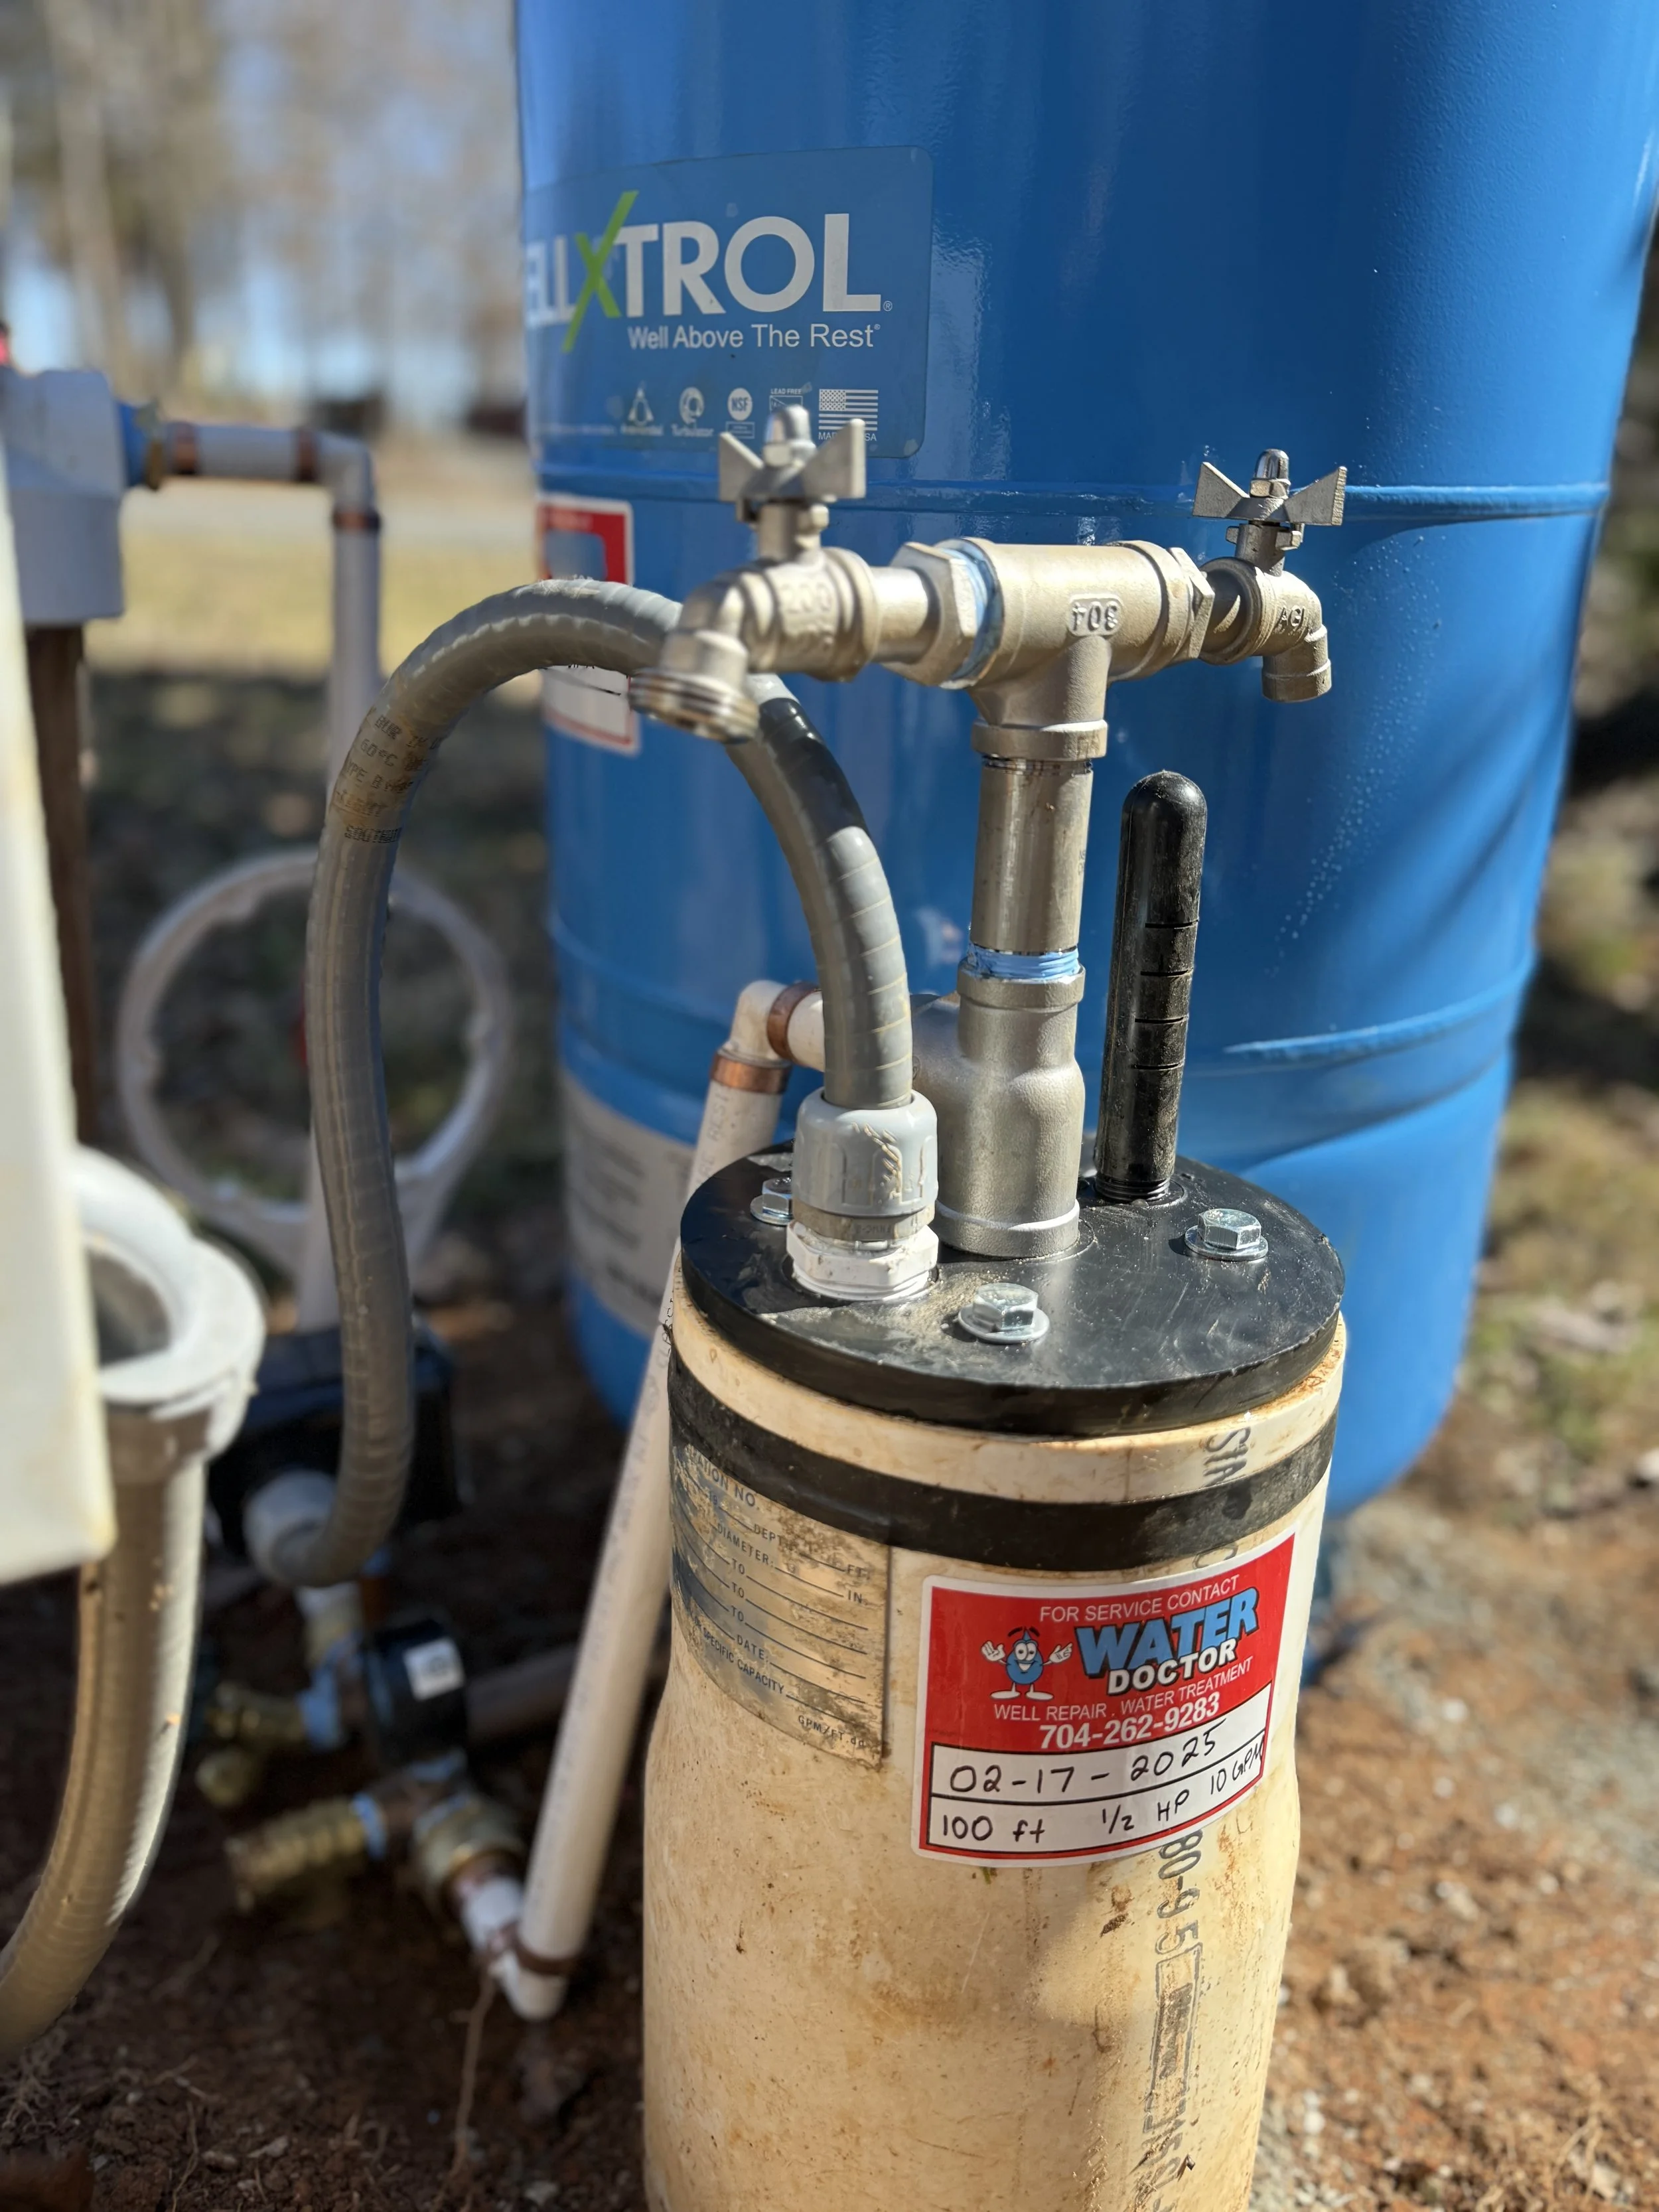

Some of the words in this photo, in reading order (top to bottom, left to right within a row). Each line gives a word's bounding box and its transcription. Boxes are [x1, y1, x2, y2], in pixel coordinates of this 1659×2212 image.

[627, 325, 669, 350] Well
[673, 325, 744, 349] Above
[751, 324, 800, 347] The
[810, 323, 874, 348] Rest
[731, 397, 750, 412] NSF
[818, 432, 836, 441] MA
[731, 1582, 745, 1599] TO
[732, 1558, 745, 1576] TO
[731, 1605, 745, 1623] TO
[1039, 1605, 1079, 1623] FOR
[1084, 1597, 1162, 1621] SERVICE
[1167, 1574, 1240, 1610] CONTACT
[1073, 1586, 1260, 1678] WATER
[703, 1627, 735, 1663] SPECIFIC
[737, 1659, 784, 1694] CAPACITY
[1106, 1637, 1238, 1696] DOCTOR
[994, 1703, 1041, 1721] WELL
[1046, 1703, 1107, 1720] REPAIR
[1120, 1691, 1175, 1714] WATER
[1178, 1656, 1254, 1698] TREATMENT
[1039, 1692, 1220, 1749] 704-262-9283
[942, 1814, 993, 1841] 100
[1012, 1817, 1045, 1844] ft
[1157, 1788, 1190, 1822] HP
